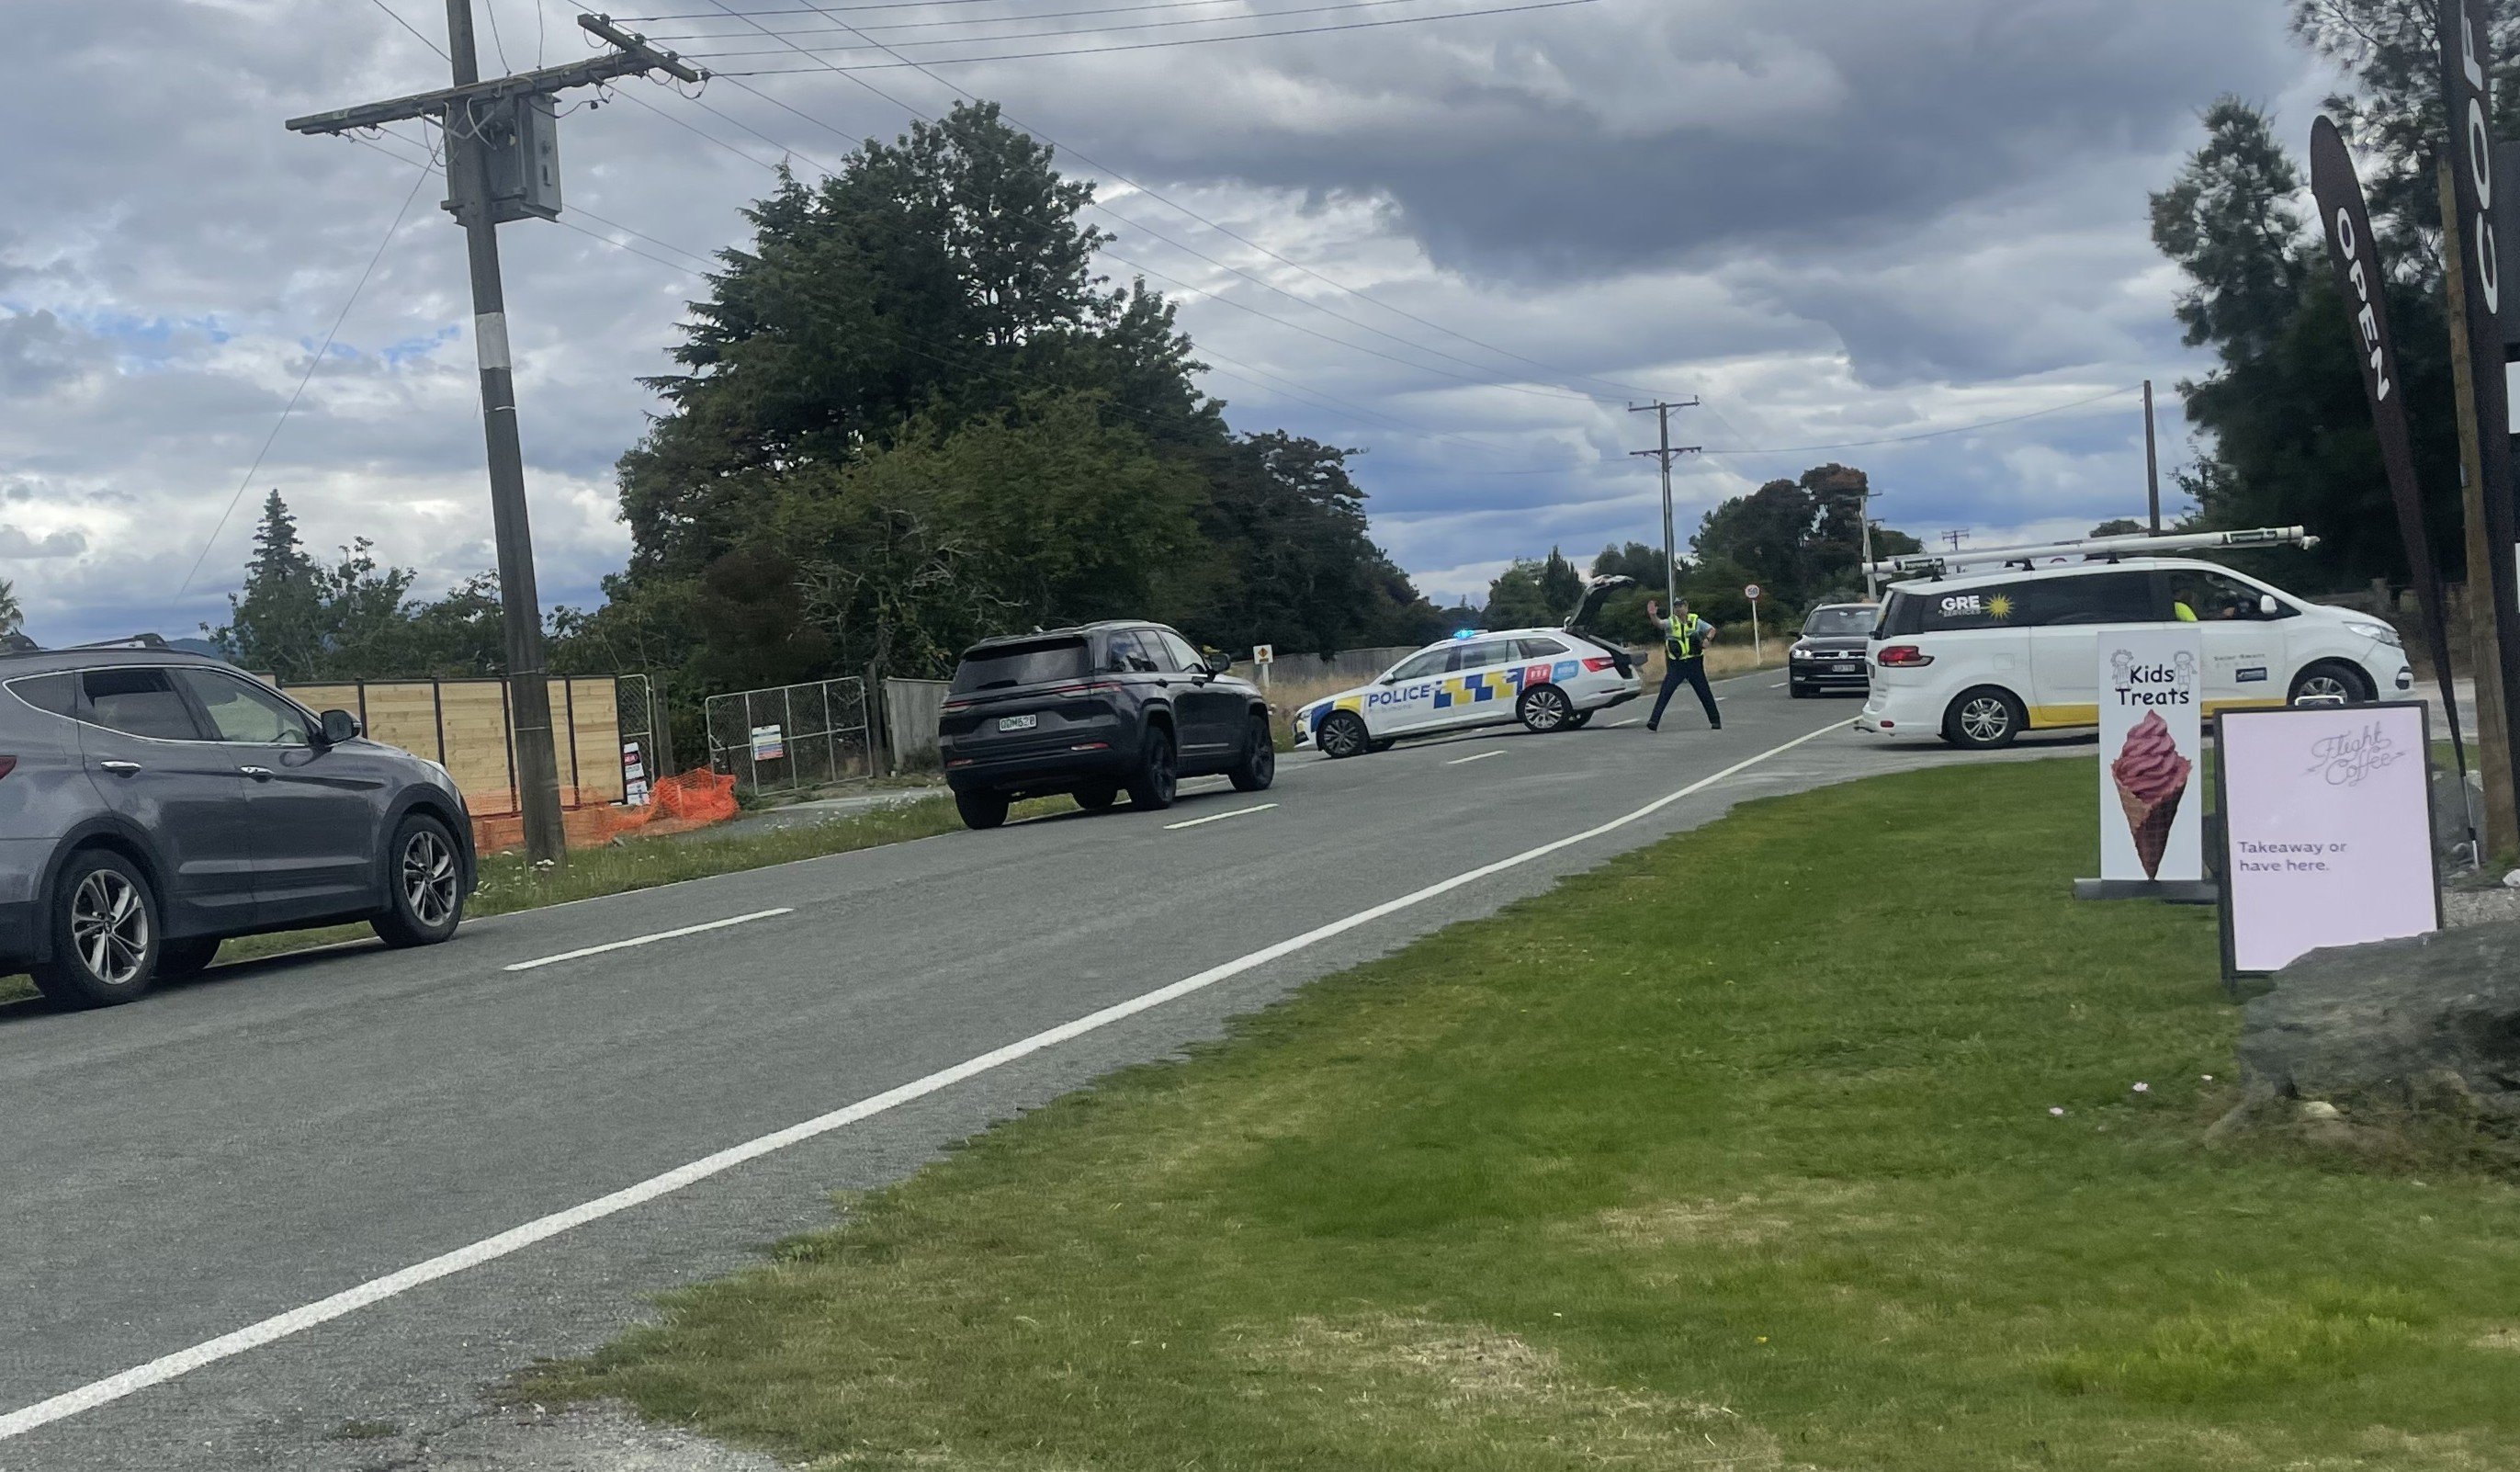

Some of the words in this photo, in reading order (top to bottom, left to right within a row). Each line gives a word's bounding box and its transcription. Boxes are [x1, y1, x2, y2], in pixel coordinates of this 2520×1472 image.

[2337, 207, 2390, 402] OPEN
[1940, 594, 1981, 611] GRE
[2130, 663, 2175, 684] Kids
[1368, 684, 1431, 707] POLICE
[2115, 687, 2189, 706] Treats
[2325, 745, 2406, 787] Coffee
[2237, 841, 2323, 855] Takeaway
[2329, 843, 2346, 853] or
[2239, 860, 2281, 871] have
[2286, 859, 2330, 871] here.
